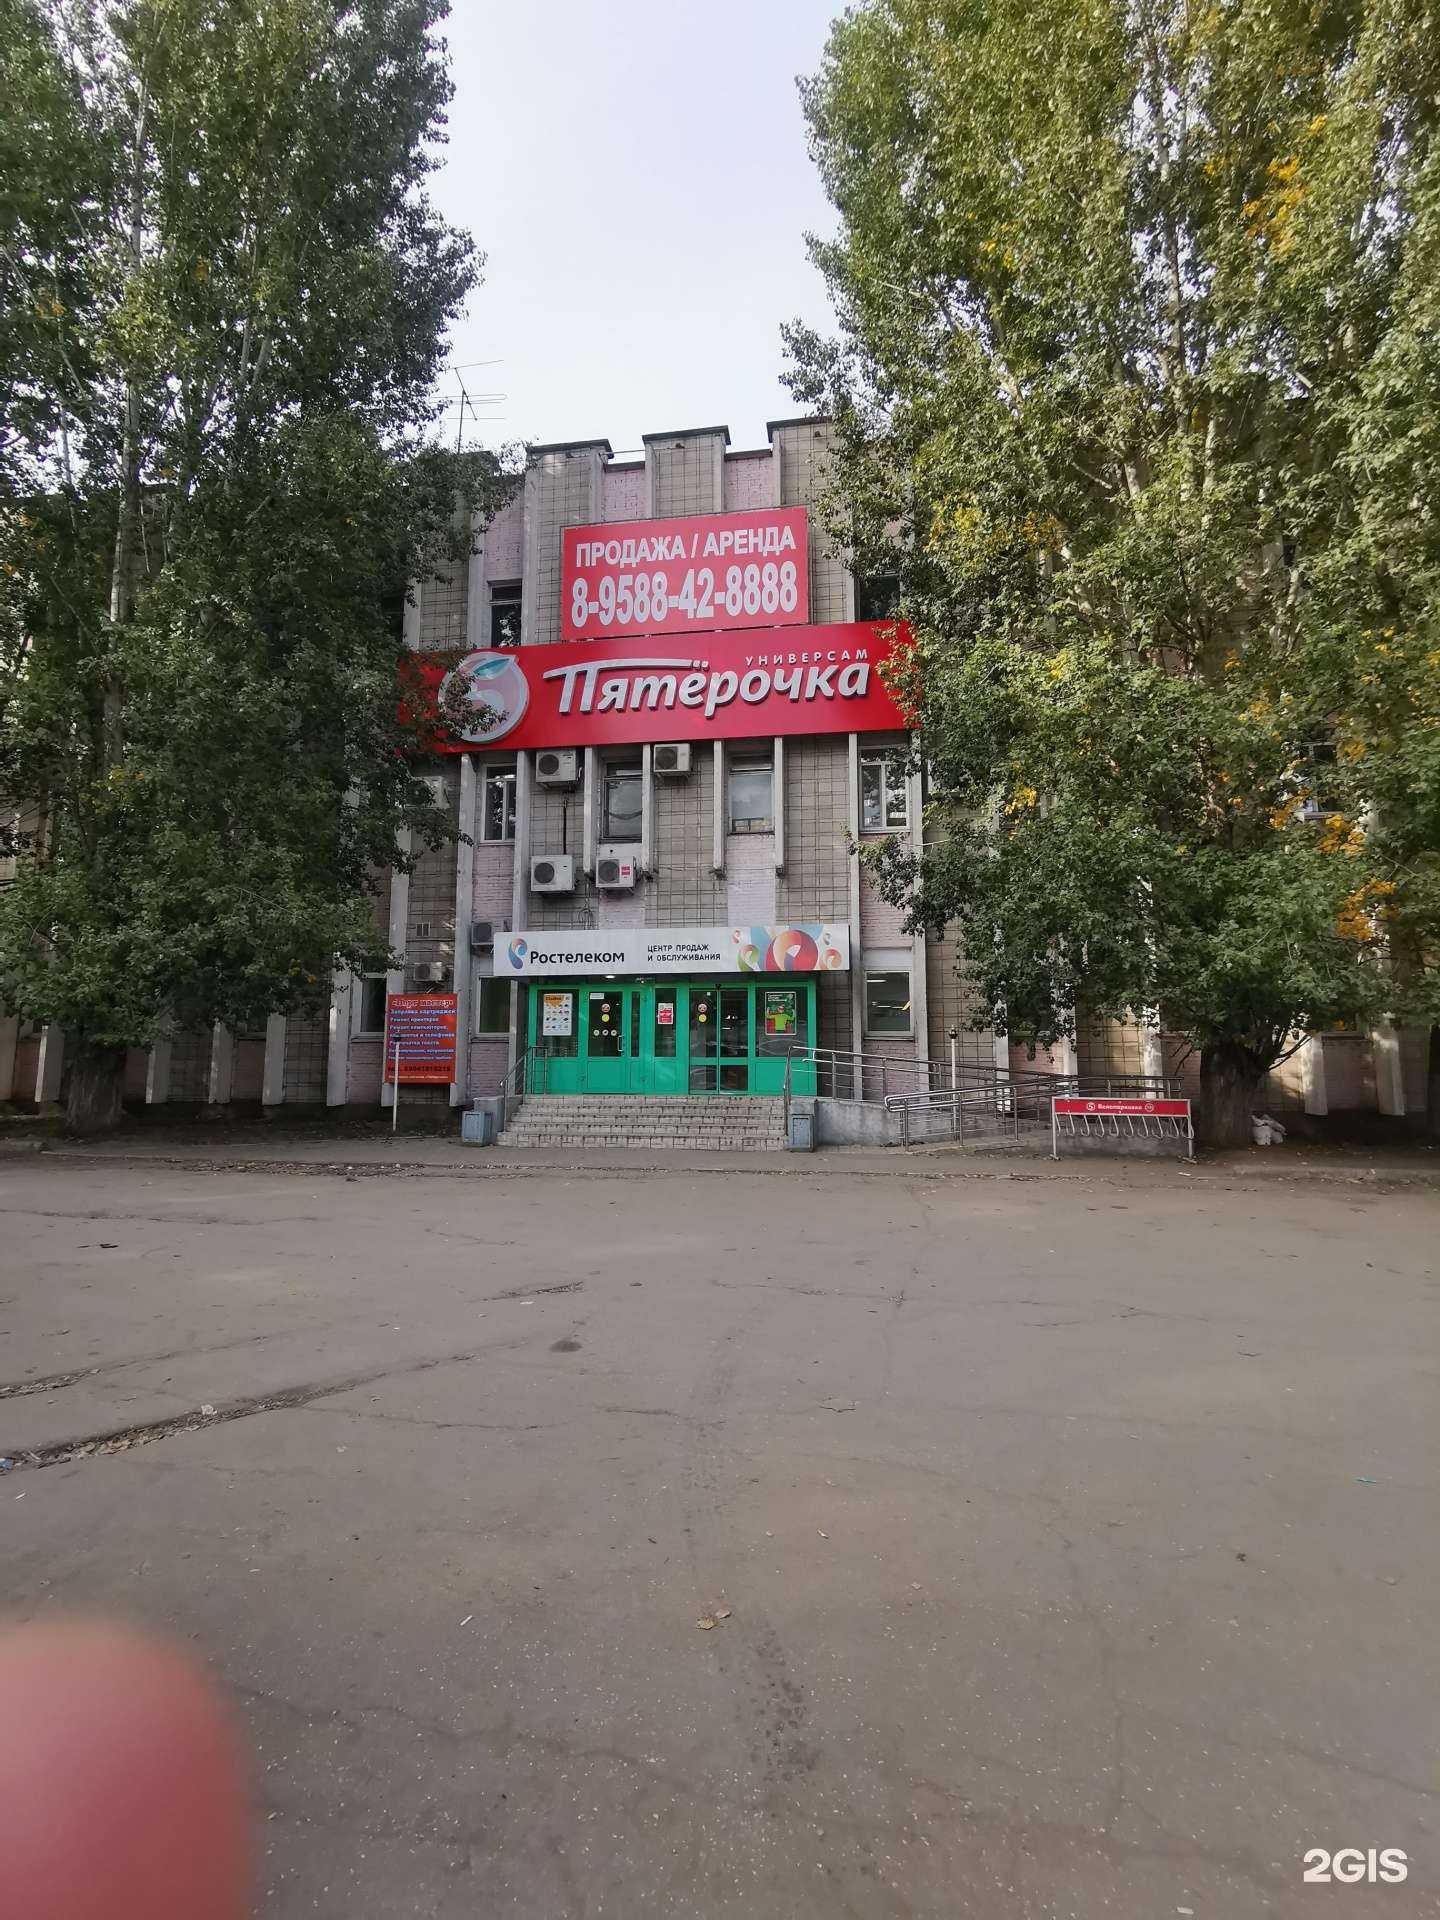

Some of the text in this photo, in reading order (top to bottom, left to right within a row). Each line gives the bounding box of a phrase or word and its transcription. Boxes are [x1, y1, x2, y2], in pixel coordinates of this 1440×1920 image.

[575, 525, 796, 569] ПРОДАЖА / АРЕНДА
[571, 560, 797, 628] 8-9588-42-8888
[744, 648, 869, 667] УНИВЕРСАМ
[543, 657, 871, 719] Пятёрочка
[647, 943, 710, 953] ЦЕНТР ПРОДАЖ
[530, 950, 626, 966] Ростелеком
[647, 953, 721, 963] И ОБСЛУЖИВАНИЯ
